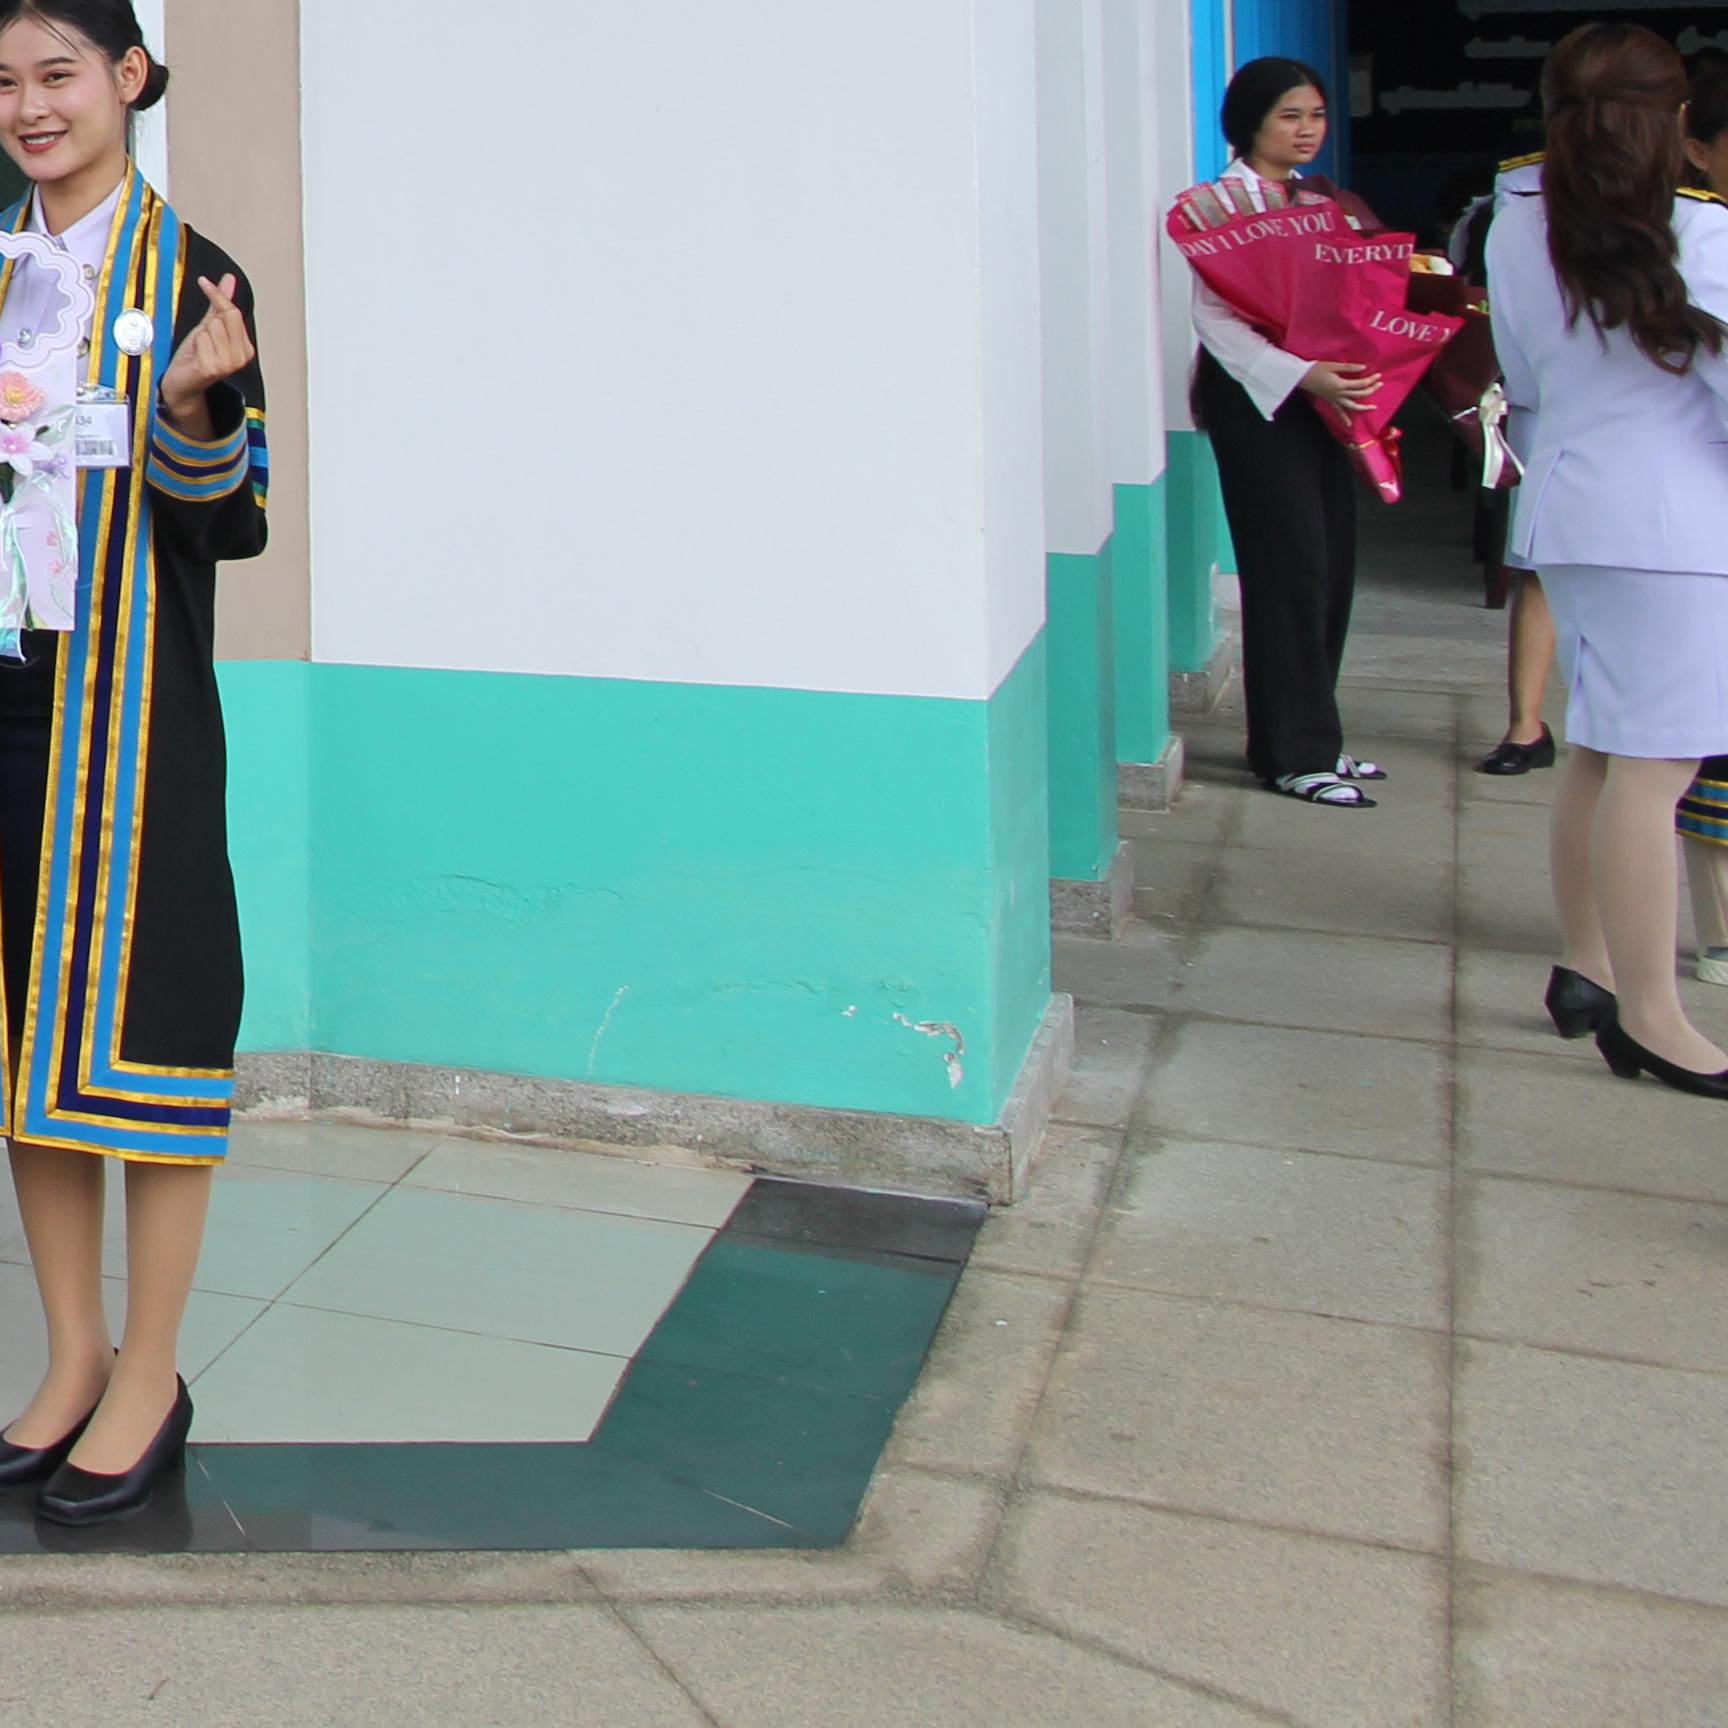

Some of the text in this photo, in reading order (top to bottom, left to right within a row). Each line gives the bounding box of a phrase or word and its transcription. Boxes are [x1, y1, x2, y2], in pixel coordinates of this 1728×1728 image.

[1233, 216, 1288, 246] LOVE
[1290, 211, 1335, 237] YOU
[1369, 310, 1437, 343] LOVE
